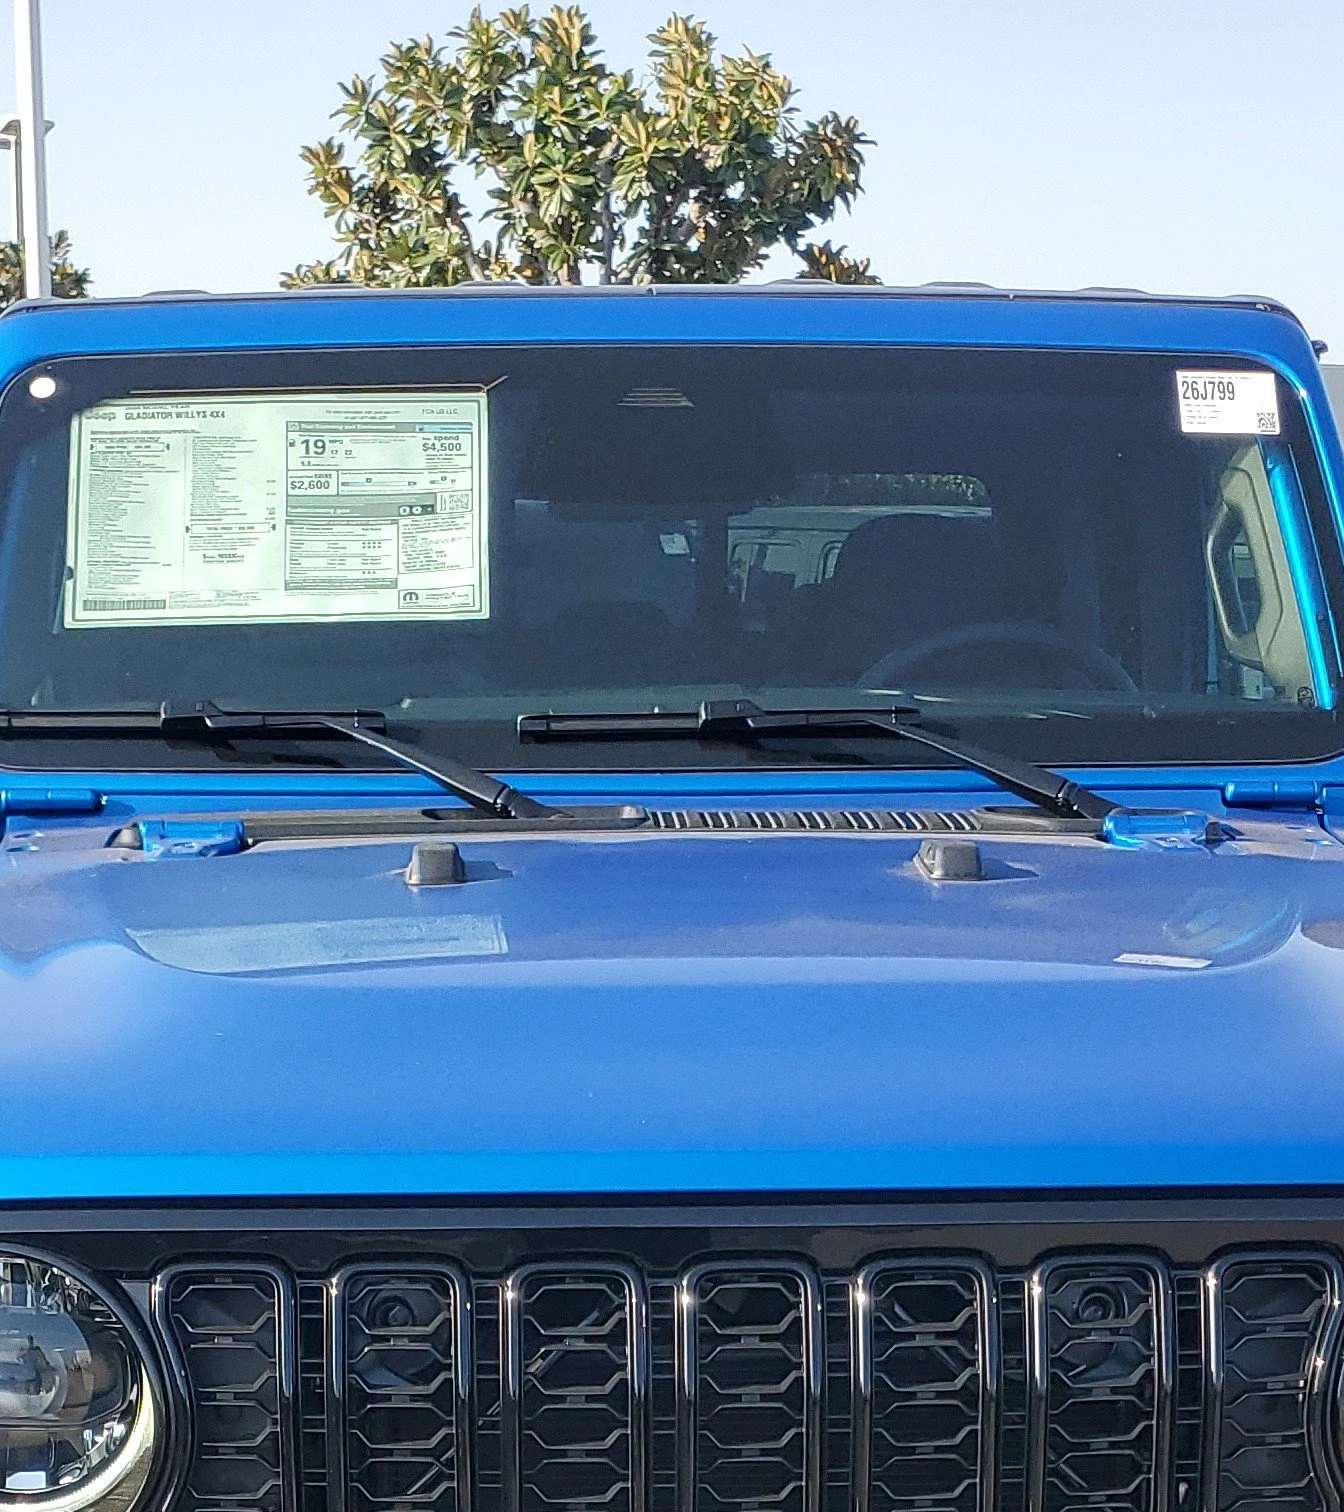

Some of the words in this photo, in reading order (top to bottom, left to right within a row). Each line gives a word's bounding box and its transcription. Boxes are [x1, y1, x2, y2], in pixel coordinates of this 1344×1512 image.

[1181, 380, 1235, 401] 26J799
[124, 411, 173, 420] GLADIATOR
[175, 410, 208, 419] WILLYS
[301, 438, 327, 456] 19
[422, 442, 462, 453] $4,500
[290, 480, 331, 491] $2,600
